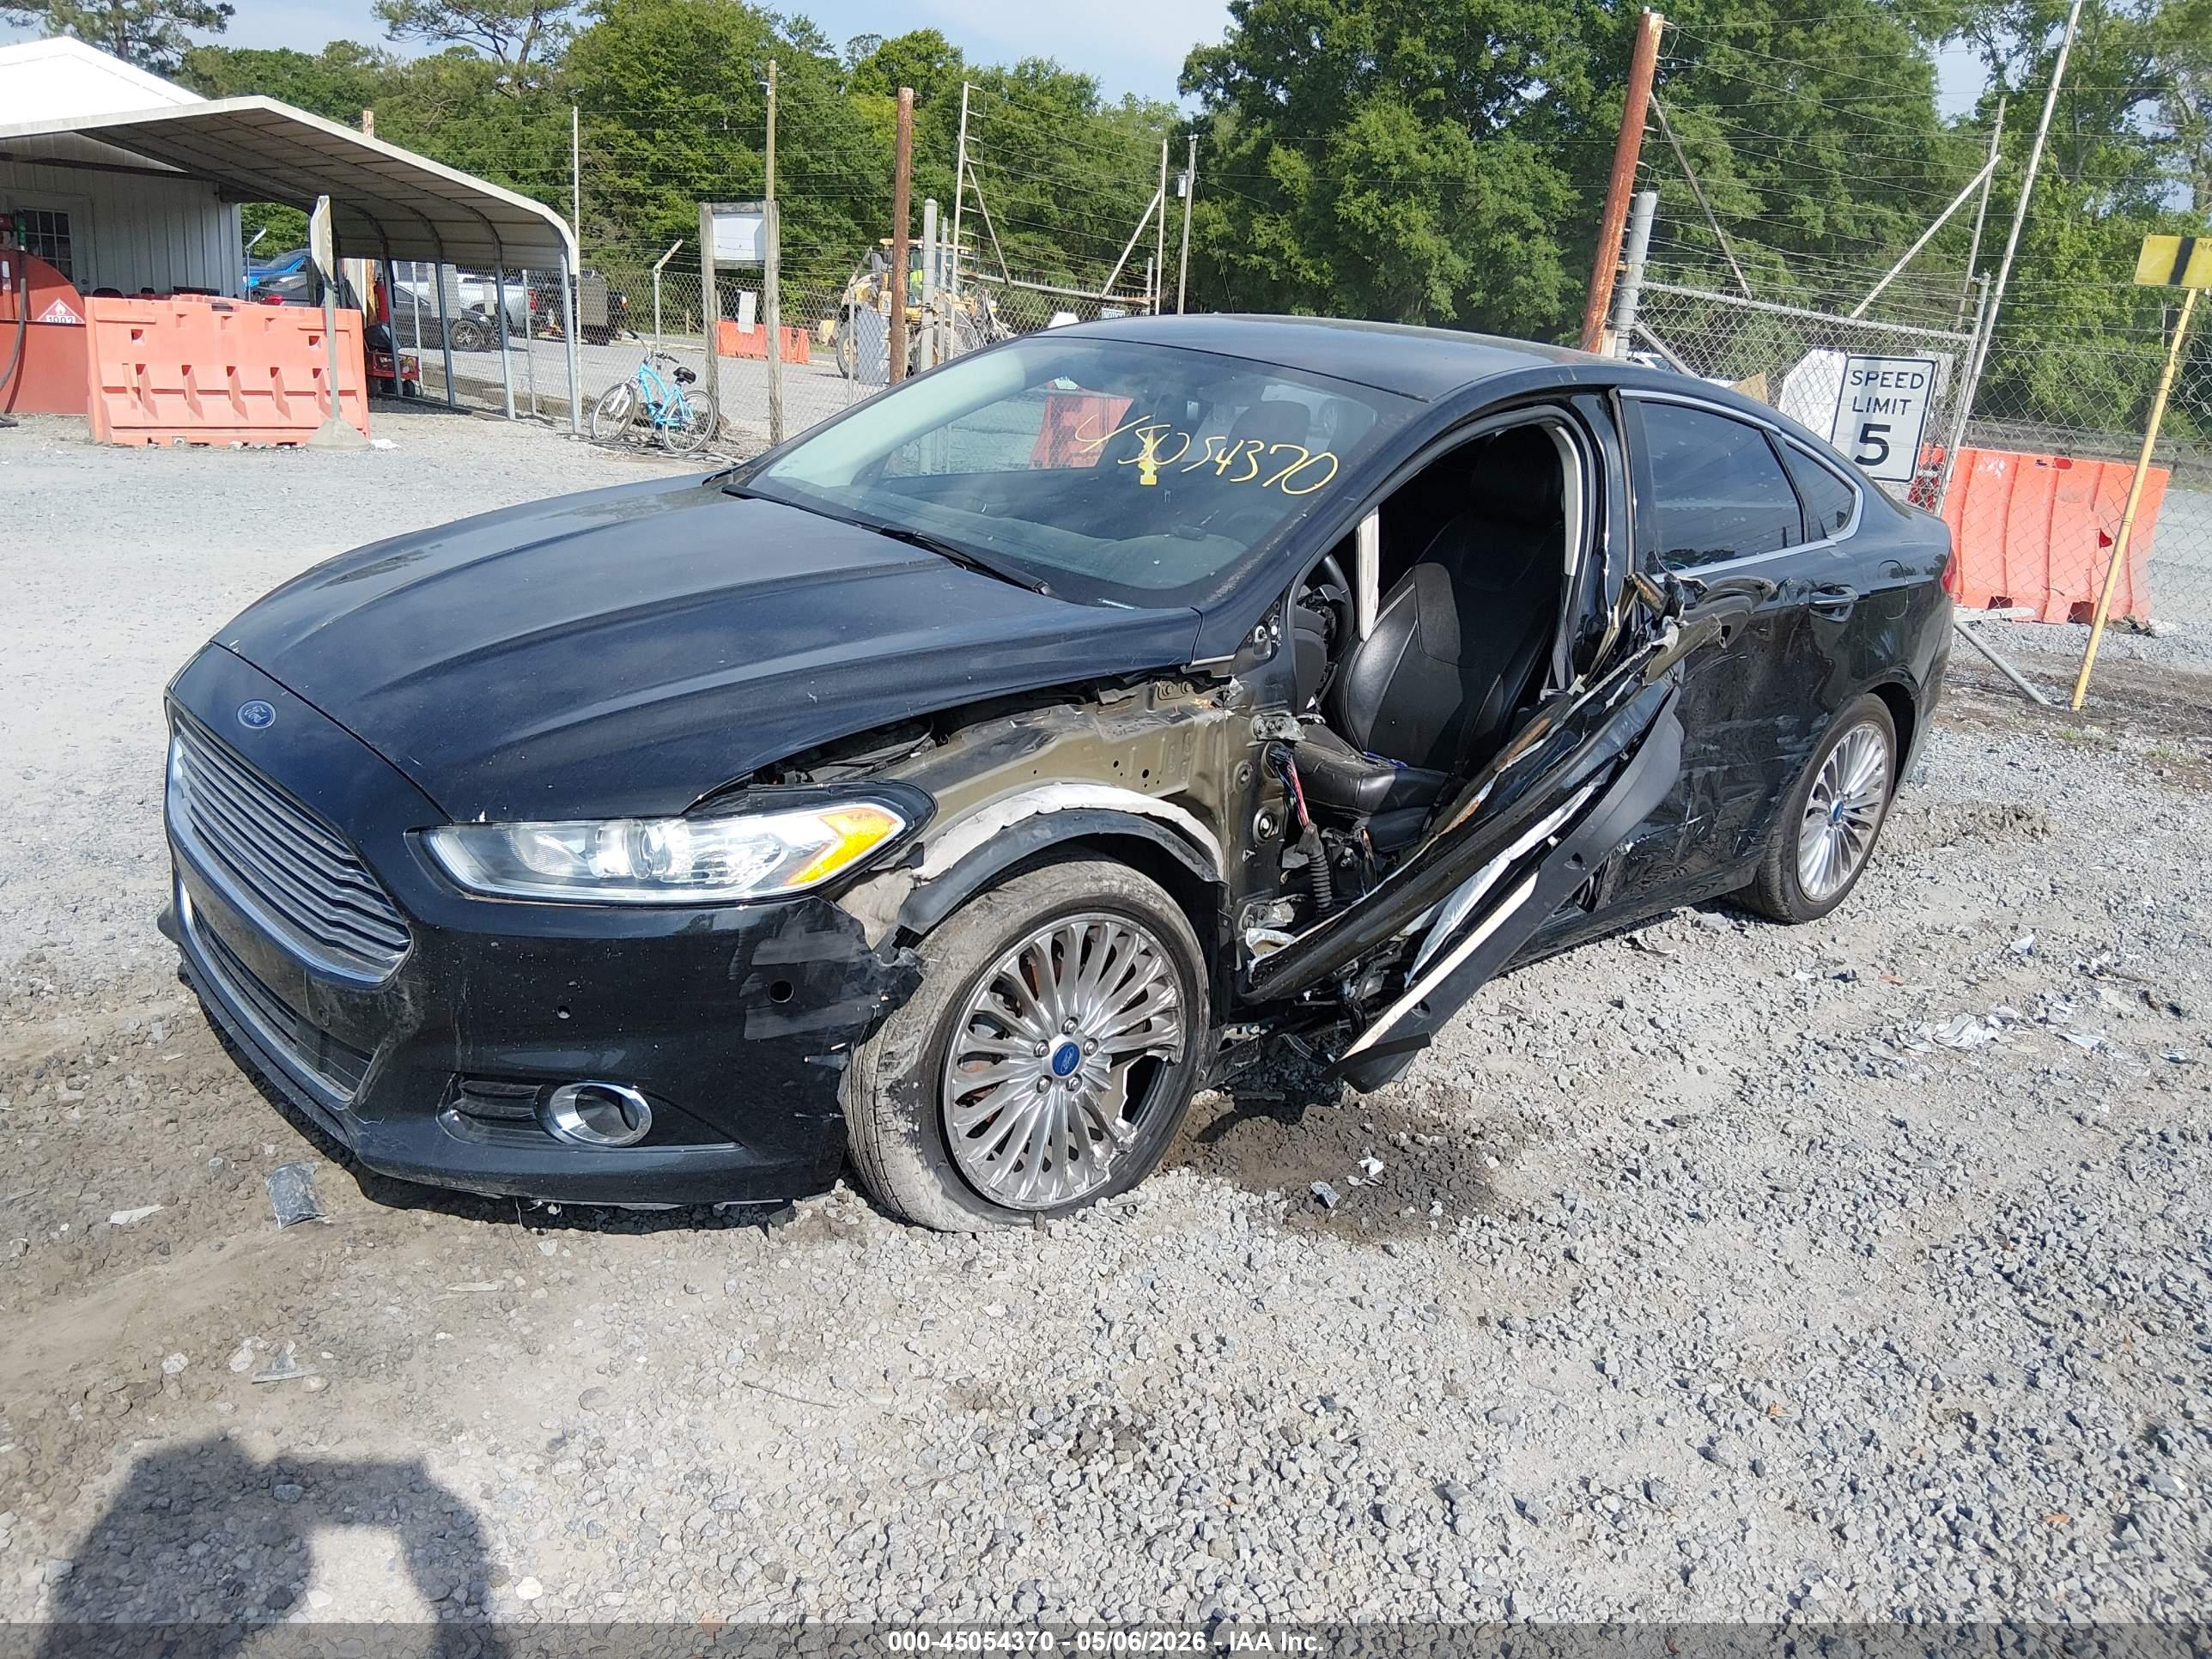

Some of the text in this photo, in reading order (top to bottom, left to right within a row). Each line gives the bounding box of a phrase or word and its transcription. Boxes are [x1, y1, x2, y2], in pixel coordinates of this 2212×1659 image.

[1850, 370, 1924, 389] SPEED
[1851, 396, 1911, 416] LIMIT
[1853, 422, 1891, 466] 5
